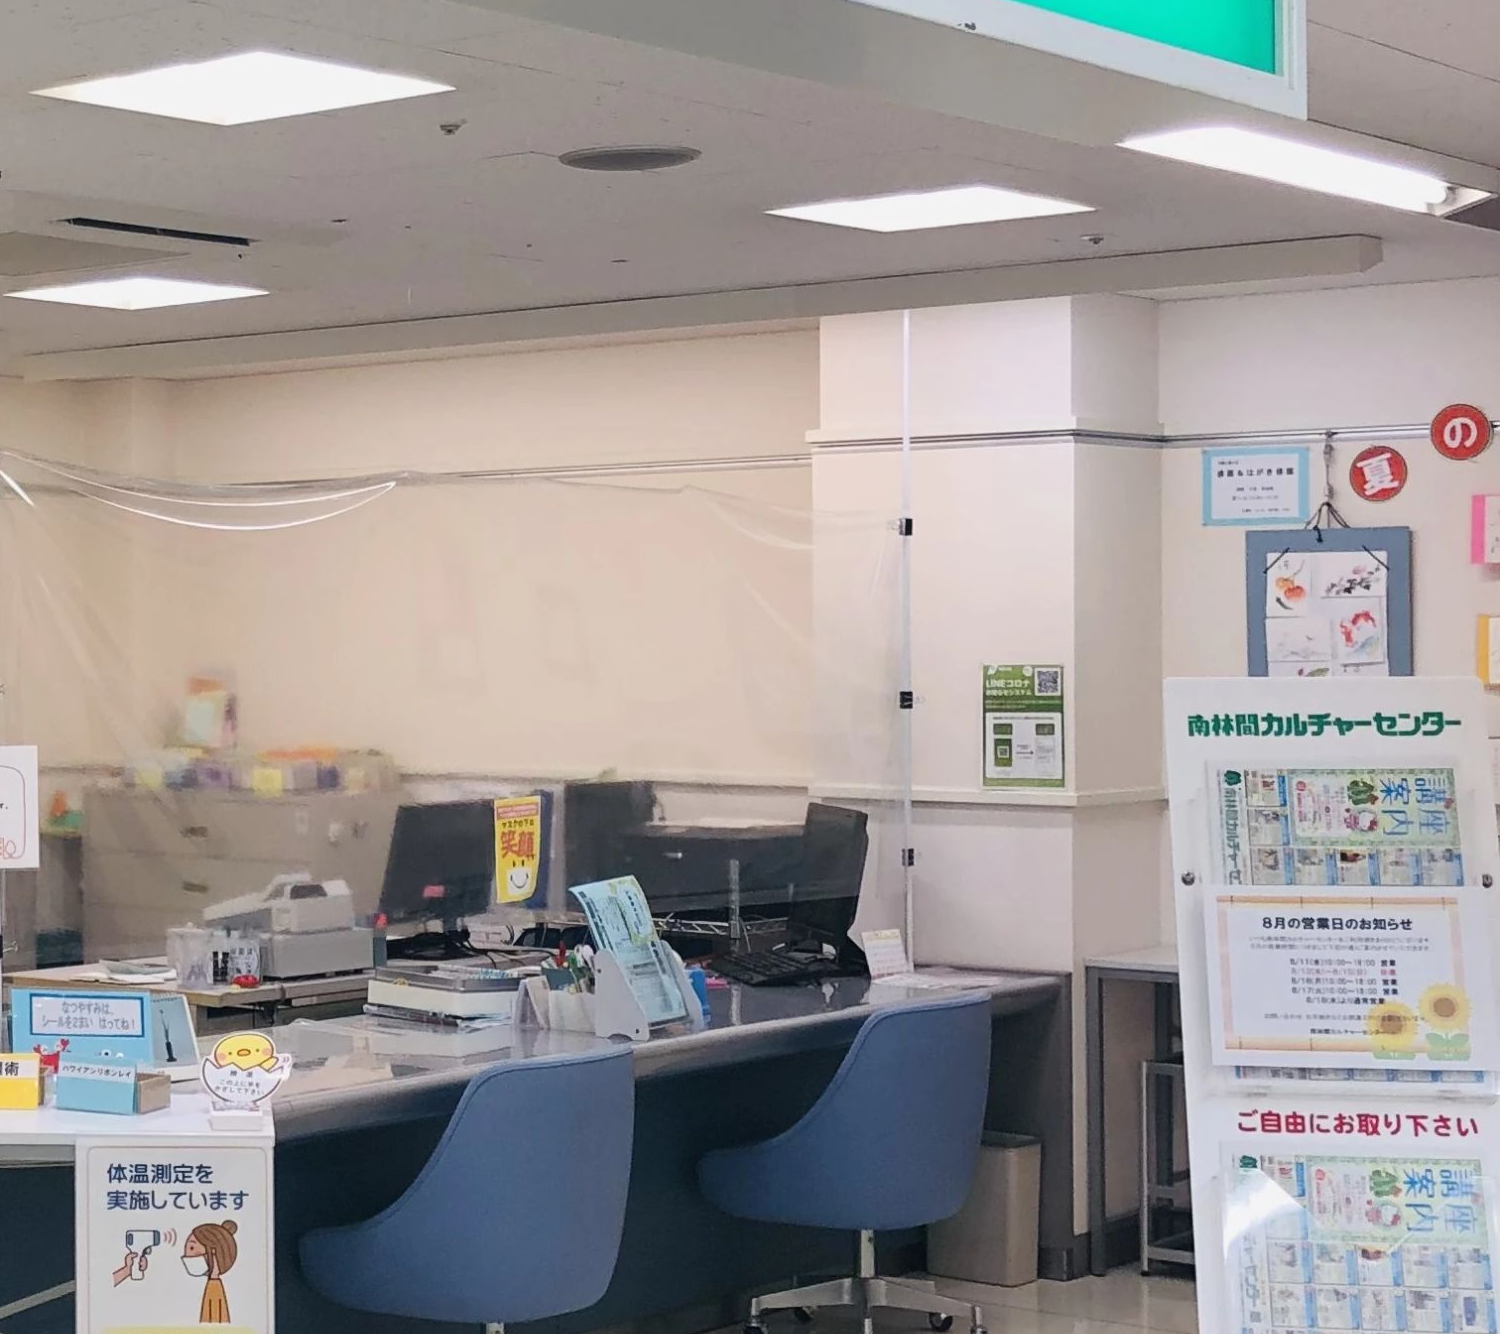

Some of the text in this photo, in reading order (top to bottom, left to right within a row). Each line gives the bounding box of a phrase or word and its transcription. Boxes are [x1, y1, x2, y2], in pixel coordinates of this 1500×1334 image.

[1443, 416, 1478, 449] の
[1355, 451, 1400, 497] 夏
[1187, 711, 1462, 737] 南林間カルチャーセンター
[1262, 916, 1413, 932] 8月の営業日のお知らせ
[62, 1065, 131, 1079] ハワイアンリボンレイ
[1237, 1108, 1480, 1139] ご自由にお取り下さい
[106, 1163, 215, 1185] 体温測定を
[106, 1189, 250, 1211] 実施しています
